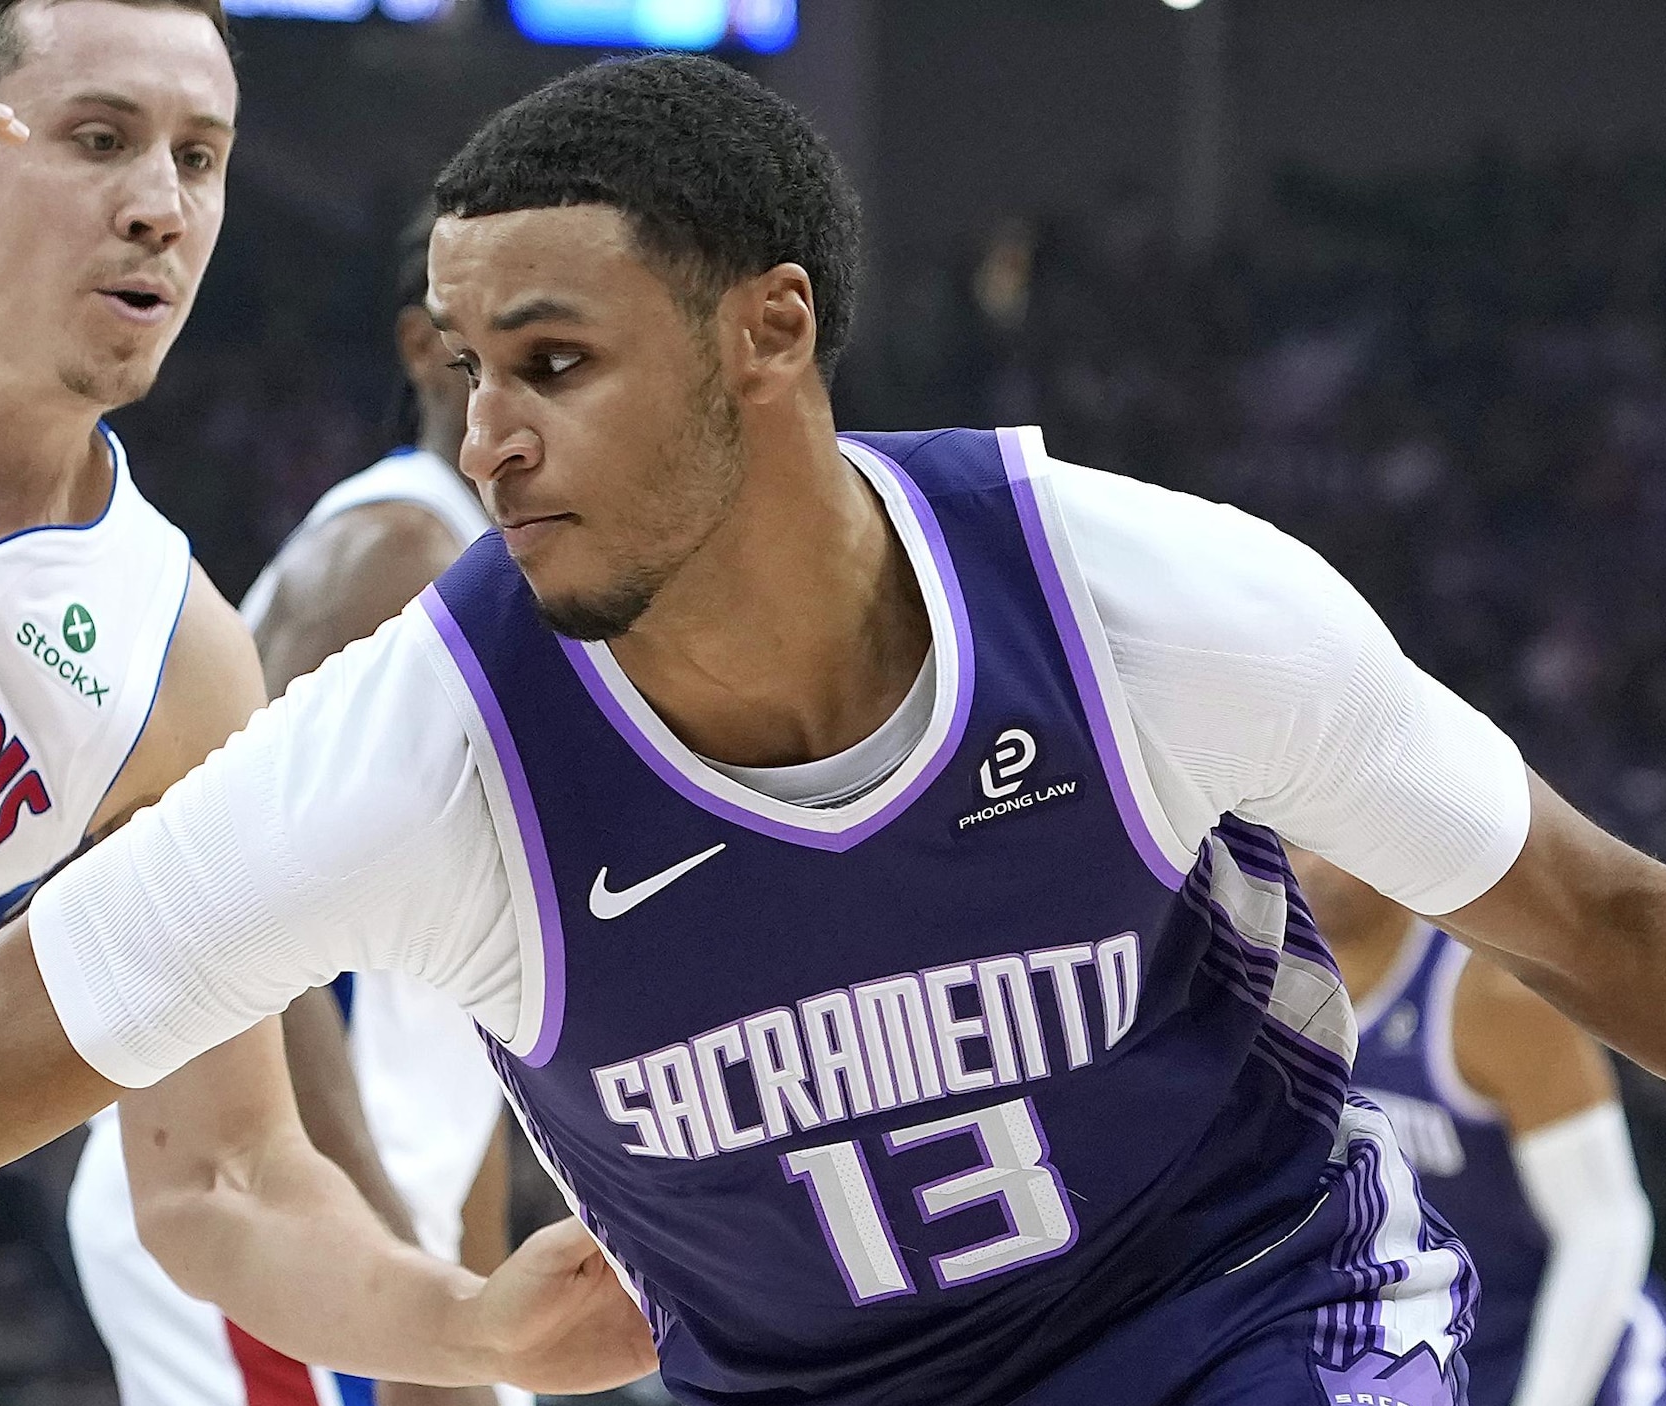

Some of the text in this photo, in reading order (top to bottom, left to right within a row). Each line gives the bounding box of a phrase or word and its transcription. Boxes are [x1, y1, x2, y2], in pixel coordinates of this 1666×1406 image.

[16, 621, 110, 708] StockX
[958, 781, 1077, 829] PHOONG LAW
[590, 930, 1142, 1161] SACRAMENTO
[778, 1095, 1081, 1307] 13
